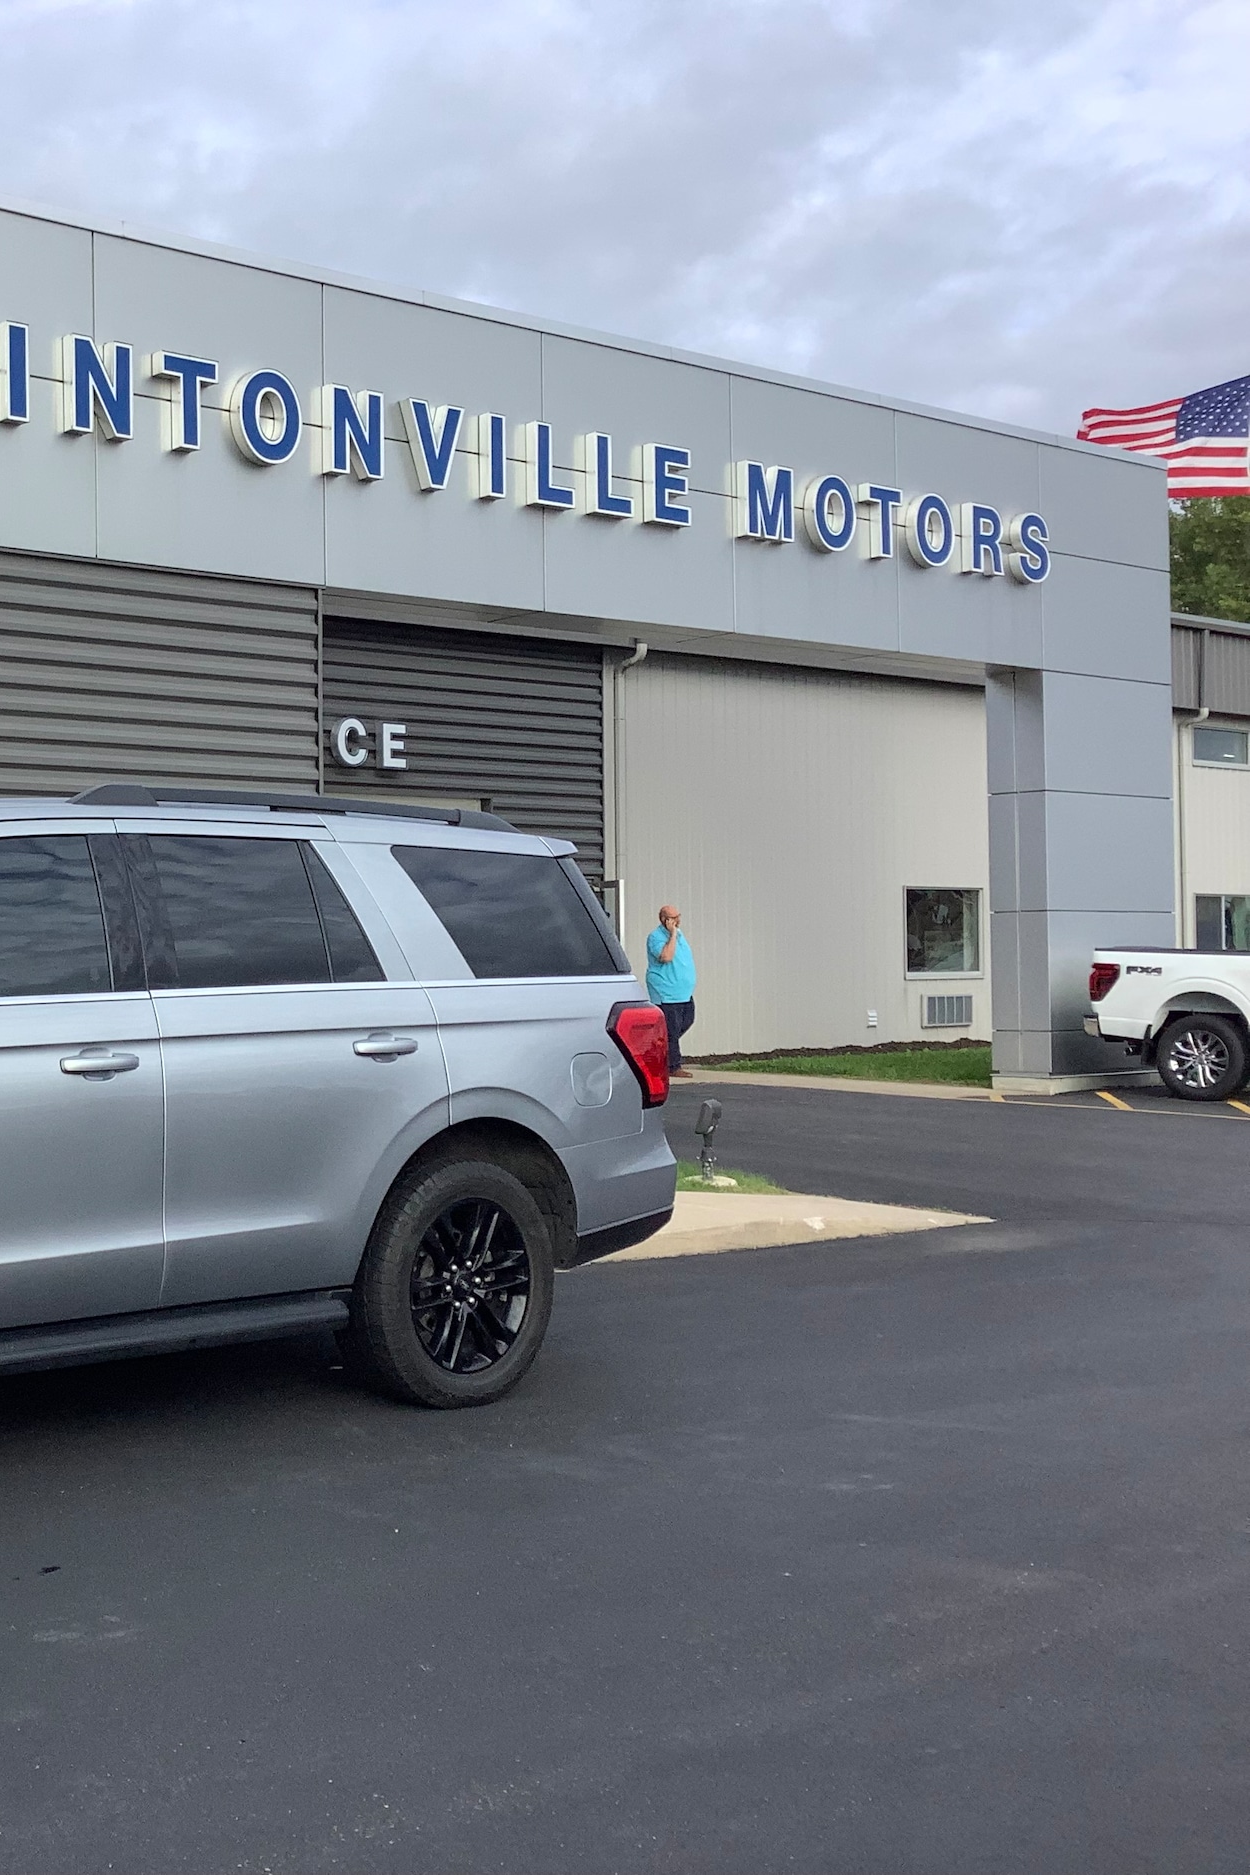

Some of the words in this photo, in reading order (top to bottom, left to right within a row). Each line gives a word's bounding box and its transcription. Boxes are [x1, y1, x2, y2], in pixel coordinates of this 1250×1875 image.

[737, 460, 1051, 584] MOTORS
[334, 717, 408, 769] CE
[1126, 966, 1162, 976] FX4
